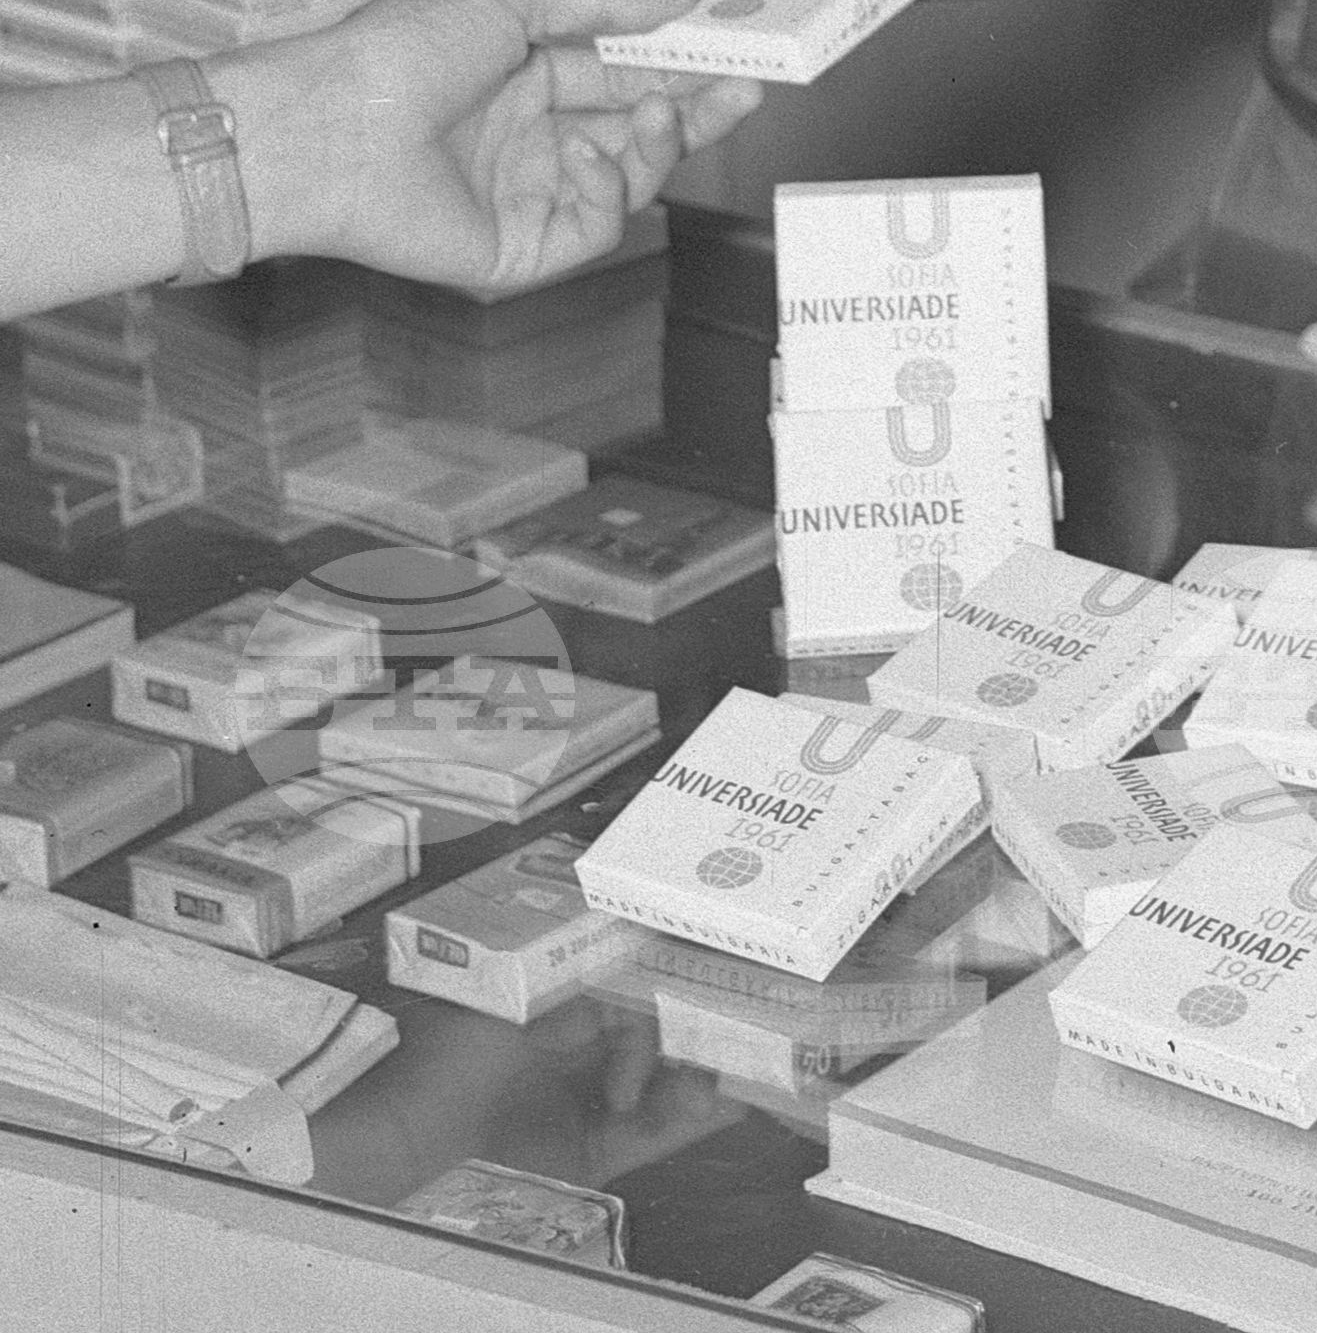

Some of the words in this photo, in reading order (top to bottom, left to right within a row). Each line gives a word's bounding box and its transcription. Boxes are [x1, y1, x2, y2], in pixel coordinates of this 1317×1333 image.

[886, 263, 957, 290] SOFIA
[777, 293, 960, 326] UNIVERSIADE
[893, 326, 959, 351] 1961
[886, 397, 952, 467] U
[886, 472, 959, 497] SOFIA
[780, 500, 965, 534] UNIVERSIADE
[894, 532, 961, 558] 1961
[944, 603, 1097, 662] UNIVERSIADE
[1051, 611, 1114, 639] SOFIA
[1004, 649, 1072, 680] 1961
[800, 708, 902, 776] U
[650, 762, 825, 832] UNIVERSIADE
[769, 767, 839, 804] SOFIA
[1106, 760, 1199, 844] UNIVERSIADE
[1182, 800, 1224, 830] SOFI
[722, 816, 796, 855] 1961
[1128, 895, 1311, 973] UNIVERSIADE
[1204, 954, 1284, 994] 1961
[1068, 1030, 1124, 1057] MADE
[1166, 1062, 1286, 1111] BULGARIA
